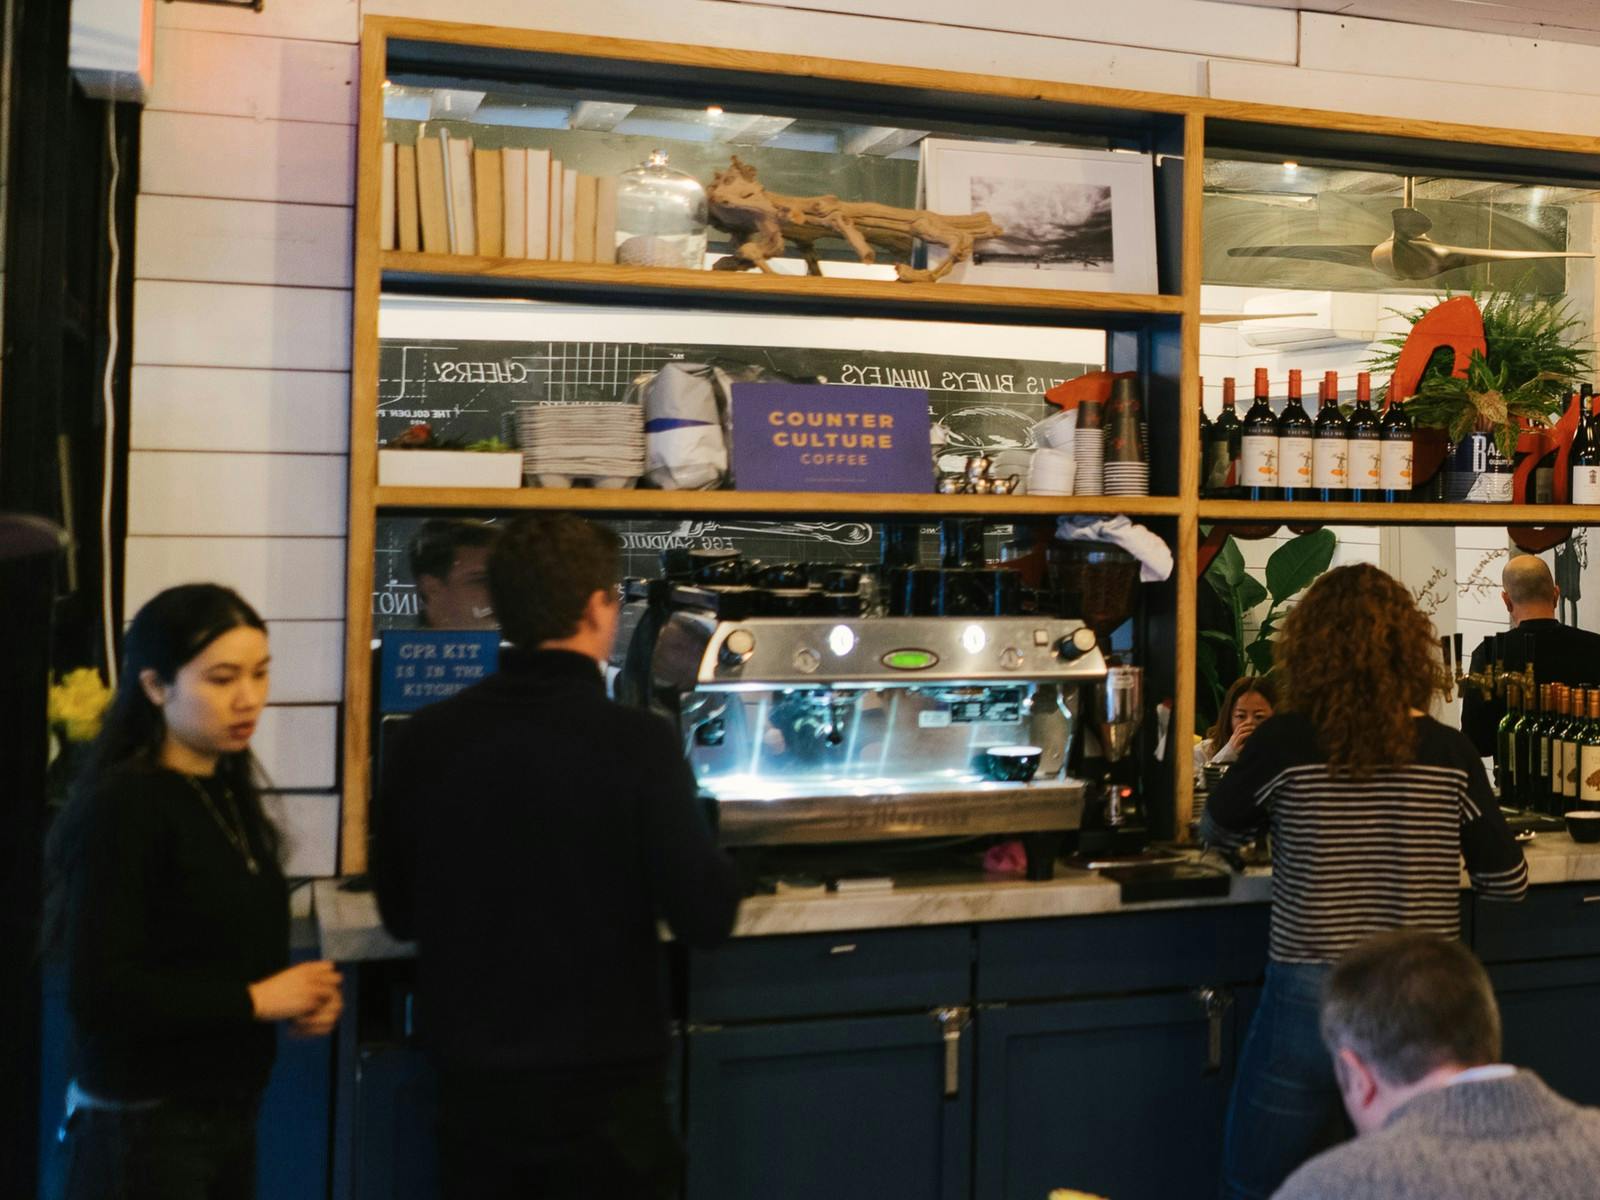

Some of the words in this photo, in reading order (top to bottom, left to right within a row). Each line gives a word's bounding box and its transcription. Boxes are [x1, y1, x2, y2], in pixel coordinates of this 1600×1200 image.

[768, 411, 894, 429] COUNTER
[772, 432, 894, 449] CULTURE
[801, 453, 870, 466] COFFEE
[400, 643, 438, 659] CPR
[443, 643, 481, 659] KIT
[395, 665, 416, 679] IS
[424, 665, 446, 679] IN
[452, 665, 485, 679] THE
